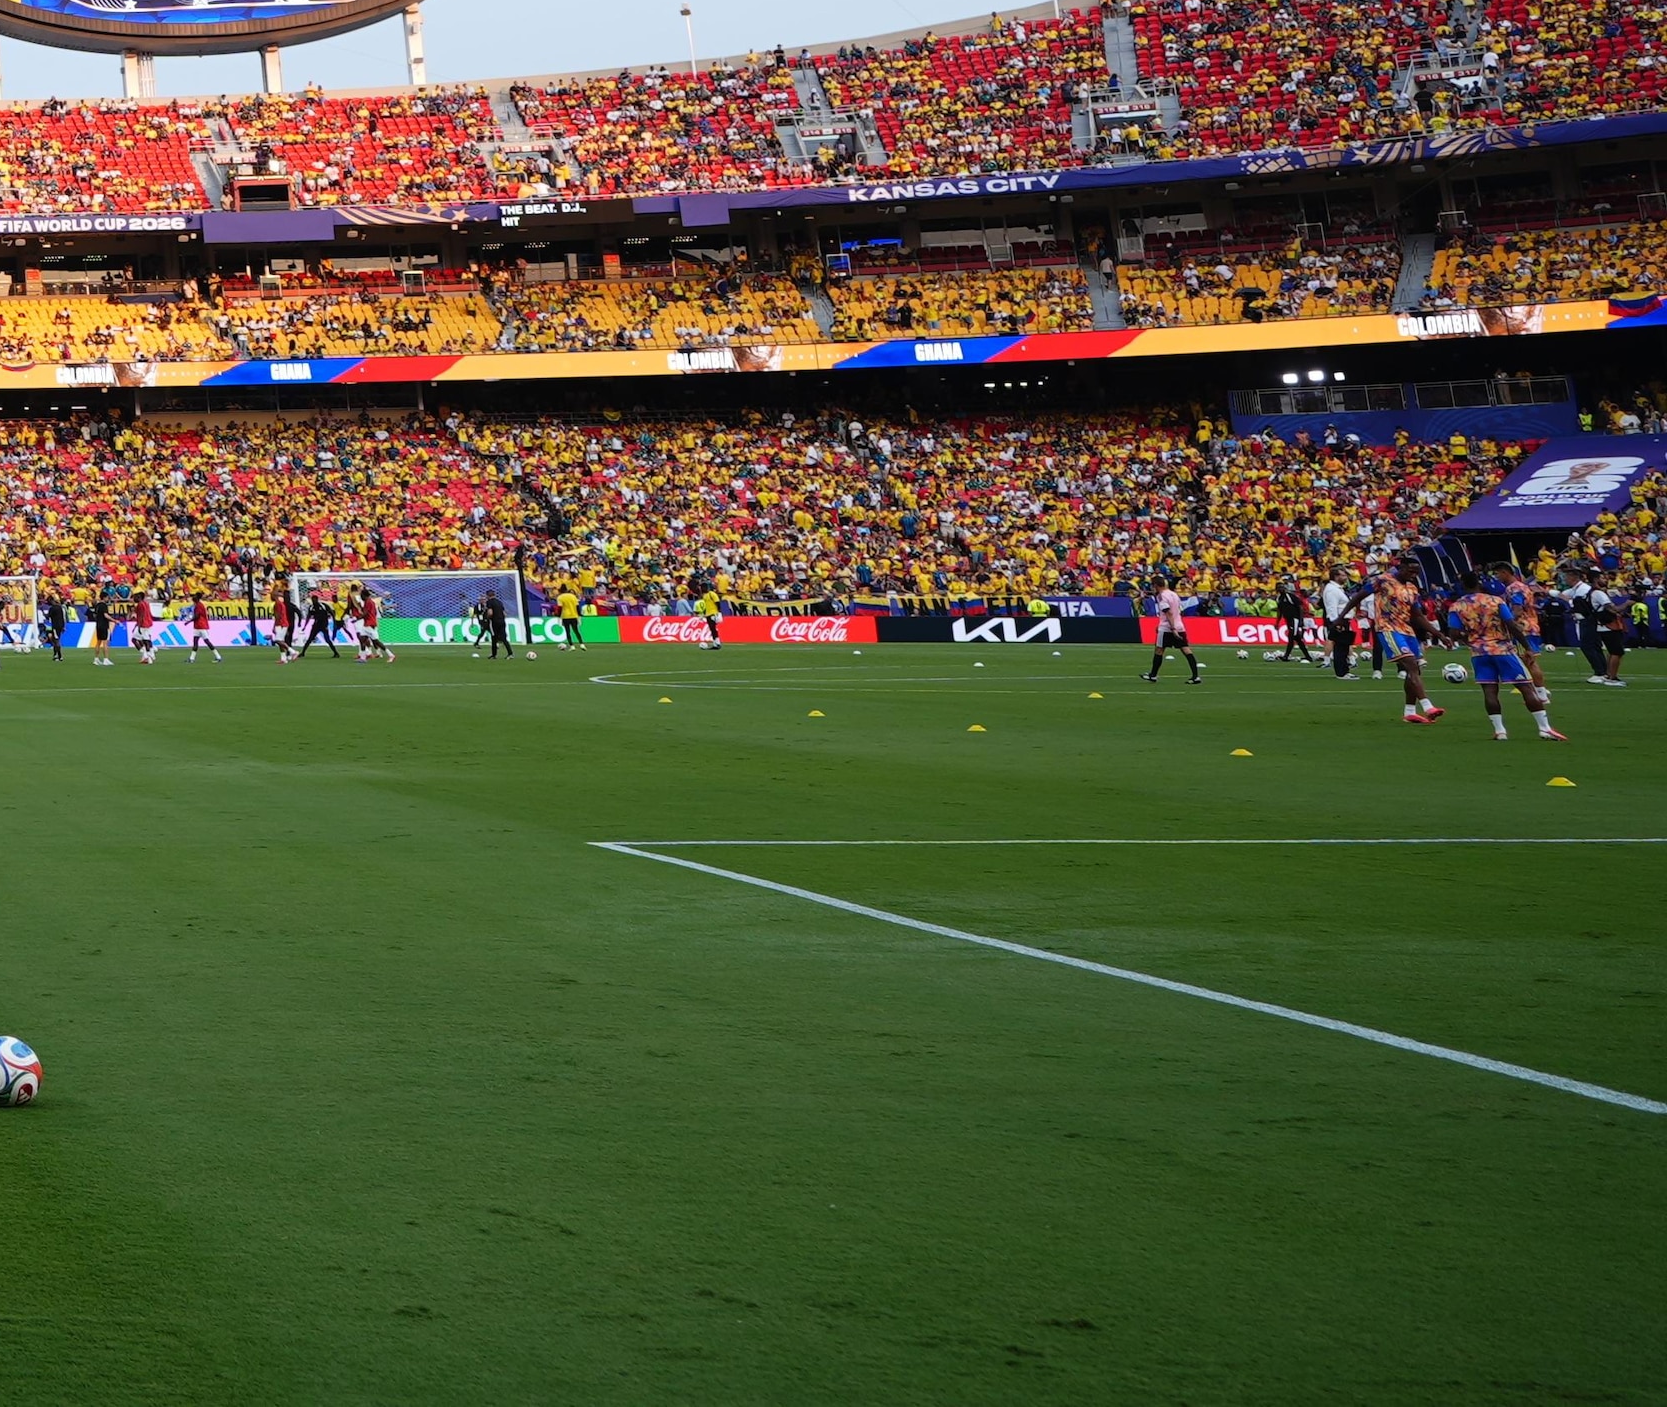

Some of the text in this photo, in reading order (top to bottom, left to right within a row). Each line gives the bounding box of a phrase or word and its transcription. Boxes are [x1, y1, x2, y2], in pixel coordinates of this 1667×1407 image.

[849, 175, 1059, 202] KANSAS CITY
[499, 205, 524, 215] THE
[525, 204, 557, 214] BEAT.
[34, 219, 85, 233] WORLD
[87, 218, 126, 232] CUP
[129, 217, 186, 231] 2026
[501, 217, 520, 226] HIT
[1397, 313, 1481, 338] COLOMBIA
[667, 351, 734, 371] COLOMBIA
[915, 342, 964, 361] GHANA
[270, 363, 312, 381] GHANA
[1498, 498, 1605, 507] 2026
[642, 616, 718, 642] Coca-Cola
[770, 616, 850, 642] Coca-Cola
